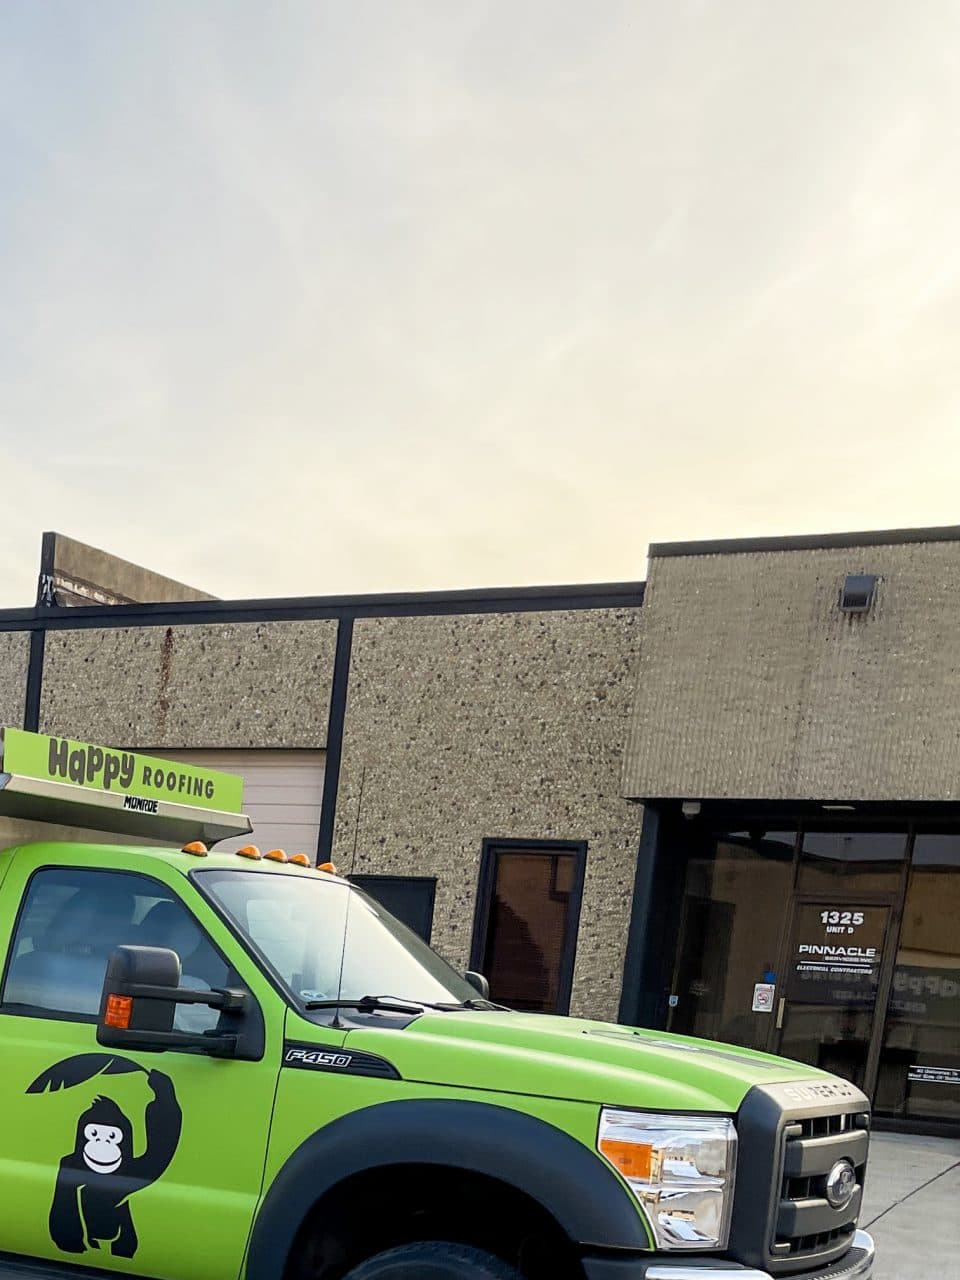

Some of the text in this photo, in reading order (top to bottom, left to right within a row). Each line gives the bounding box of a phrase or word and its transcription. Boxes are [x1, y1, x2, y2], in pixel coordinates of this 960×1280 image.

[48, 738, 215, 799] Happy ROOFING
[123, 795, 159, 814] MONROE
[820, 911, 864, 925] 1325
[826, 926, 846, 934] UNIT
[799, 945, 876, 957] PINNACLE
